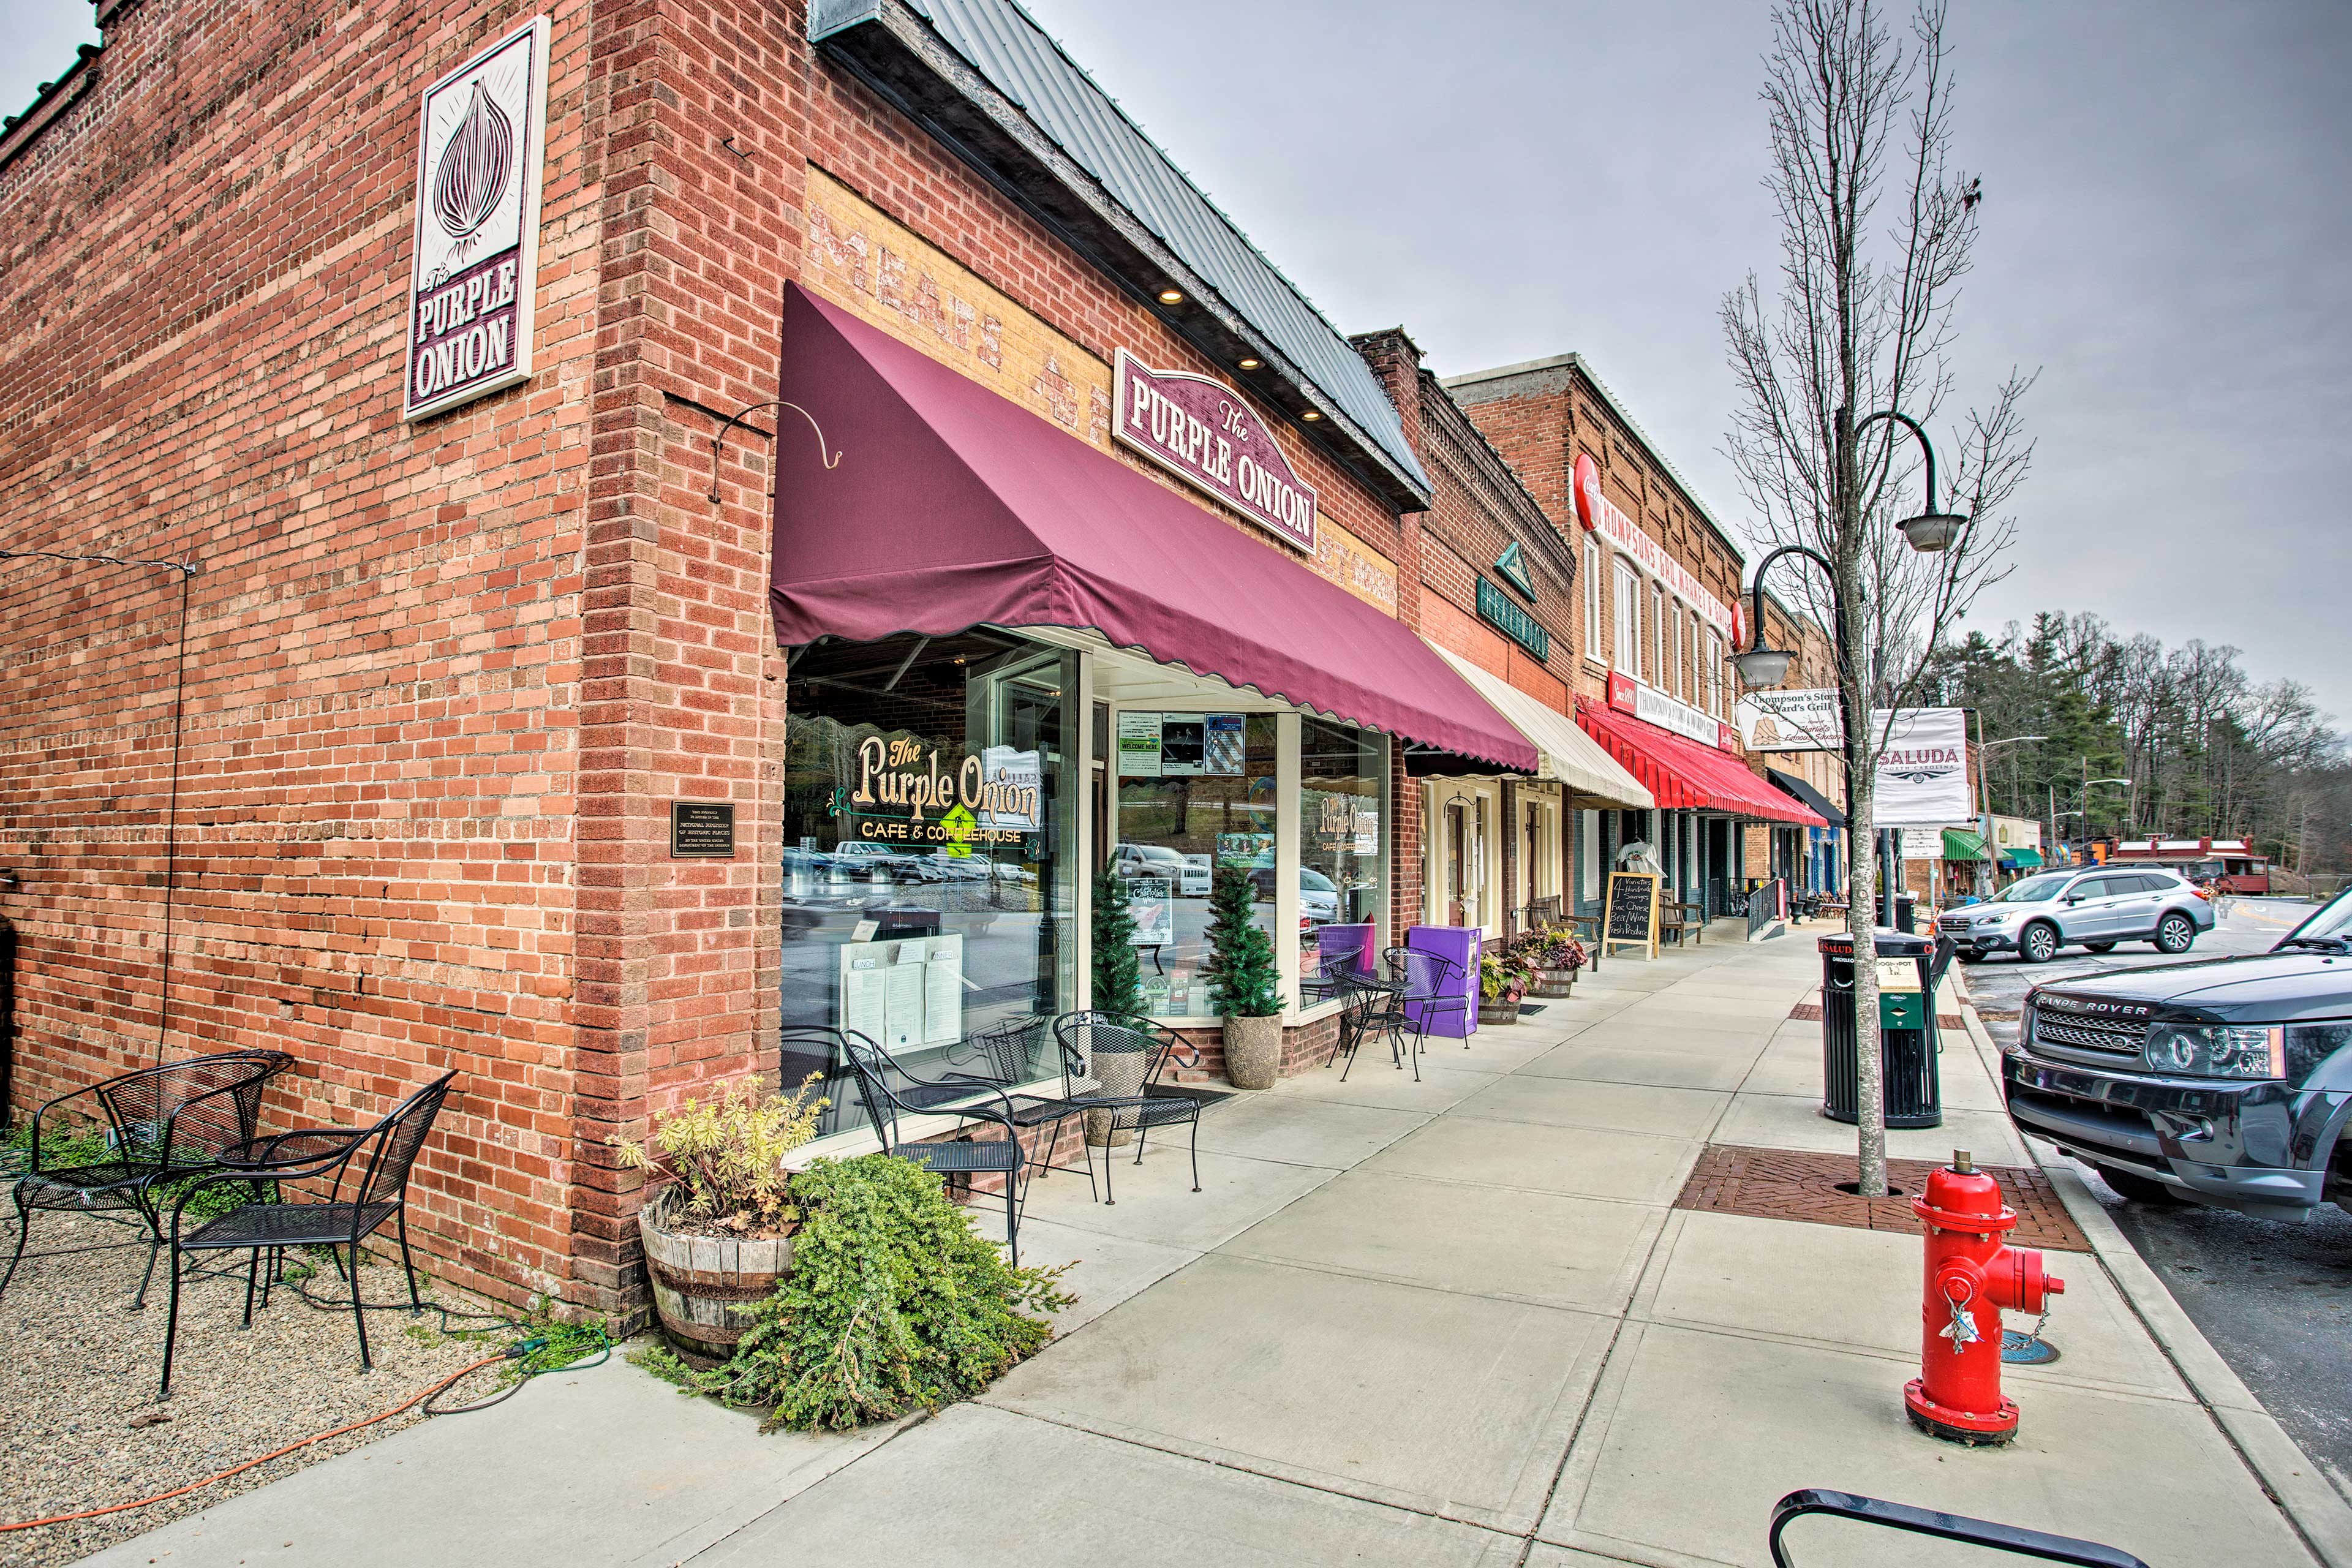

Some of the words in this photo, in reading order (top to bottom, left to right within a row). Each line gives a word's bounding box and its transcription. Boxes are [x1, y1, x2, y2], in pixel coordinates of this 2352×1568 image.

[425, 262, 451, 292] The
[417, 258, 516, 344] PURPLE
[417, 314, 510, 398] ONION
[1218, 399, 1249, 442] The
[1131, 374, 1231, 488] PURPLE
[1238, 455, 1310, 538] ONION
[1679, 568, 1705, 612] MARKET
[1487, 584, 1545, 656] HEARTWOOD
[1639, 690, 1671, 718] THOMPSON'S
[1752, 693, 1812, 704] Thompson's
[1807, 703, 1831, 711] Grill
[889, 737, 921, 767] The
[1878, 748, 1959, 766] SALUDA
[851, 736, 954, 823] Purple
[960, 755, 1038, 826] Onion
[1319, 797, 1349, 840] Purple
[1349, 803, 1374, 841] Onion
[862, 822, 908, 839] CAFE
[913, 825, 924, 839] &
[927, 825, 1021, 843] COFFEEHOUSE
[1322, 842, 1336, 851] CAFE
[1613, 878, 1624, 899] 4
[1610, 911, 1648, 923] Beer/Wine
[1611, 900, 1625, 911] Fine
[1626, 901, 1649, 913] Cheese
[1609, 924, 1624, 935] Fresh
[1625, 923, 1648, 937] Produce
[1823, 942, 1854, 954] SALUD
[854, 960, 875, 968] LUNCH
[2038, 995, 2078, 1009] RANGE
[2086, 1003, 2148, 1016] ROVER
